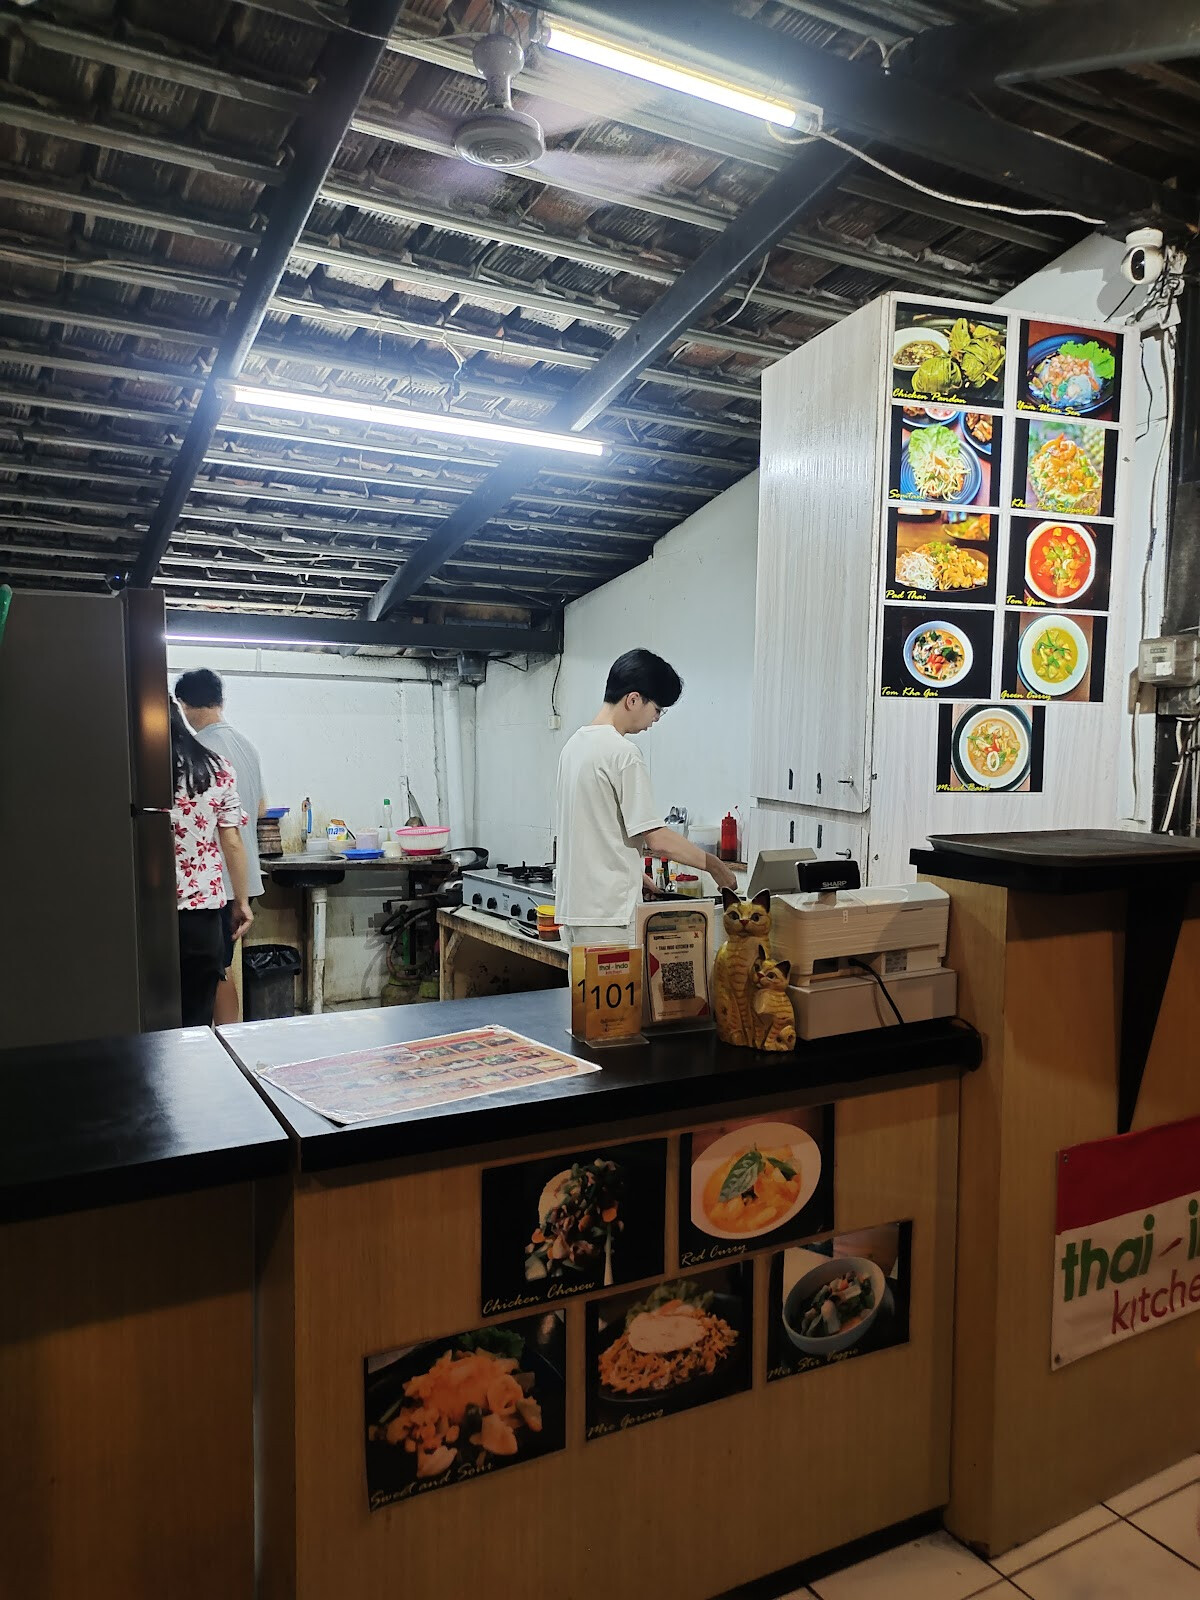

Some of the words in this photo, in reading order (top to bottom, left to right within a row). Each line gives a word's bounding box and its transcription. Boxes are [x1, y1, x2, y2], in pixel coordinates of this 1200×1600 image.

[892, 388, 928, 400] Chicken
[930, 392, 967, 404] Pandan
[1017, 400, 1036, 411] Yam
[1039, 403, 1062, 414] Woon
[1064, 406, 1081, 417] Sen
[885, 589, 905, 598] Pad
[906, 590, 927, 600] Thai
[1006, 595, 1023, 604] Tom
[1026, 597, 1046, 607] Yum
[881, 686, 899, 695] Tom
[902, 687, 921, 696] Kha
[923, 688, 939, 699] Gai
[1000, 690, 1024, 700] Green
[1026, 691, 1051, 701] Curry
[822, 880, 848, 888] SHARP
[590, 981, 635, 1010] 101
[681, 1248, 706, 1266] Red
[709, 1244, 747, 1258] Curry
[1061, 1213, 1155, 1303] thai
[1187, 1199, 1200, 1261] i
[482, 1293, 541, 1315] Chicken
[546, 1281, 595, 1299] Chasew
[620, 1408, 664, 1430] Goreng
[418, 1469, 452, 1491] and
